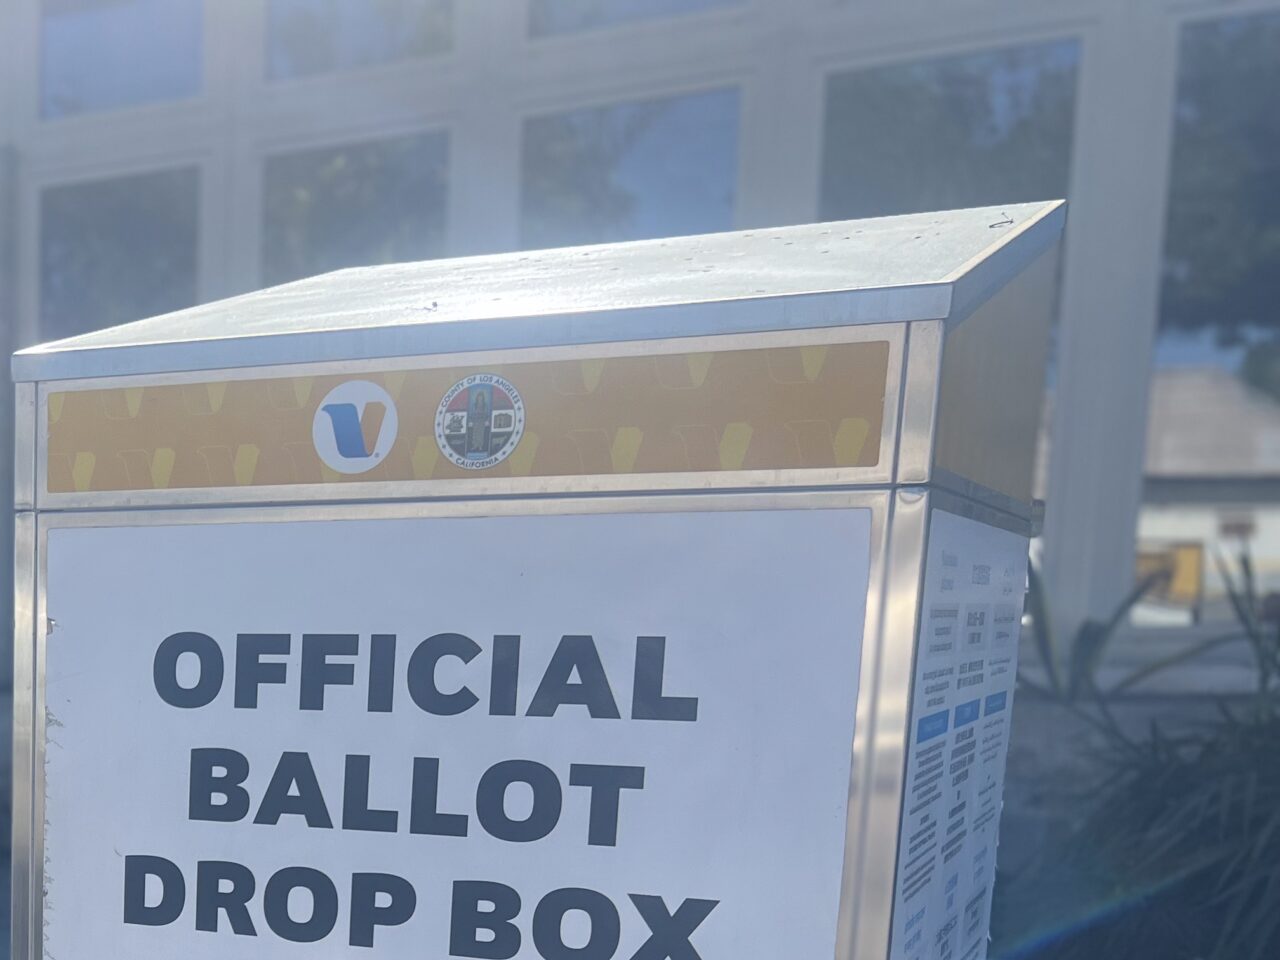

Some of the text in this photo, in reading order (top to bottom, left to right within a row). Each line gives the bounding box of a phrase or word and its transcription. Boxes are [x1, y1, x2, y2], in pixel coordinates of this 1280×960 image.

[441, 382, 465, 408] COUNTY
[479, 375, 493, 384] LOS
[494, 377, 521, 405] ANGELES
[455, 457, 500, 470] CALIFORNIA
[153, 631, 699, 722] OFFICIAL
[188, 747, 645, 847] BALLOT
[123, 854, 417, 948] DROP
